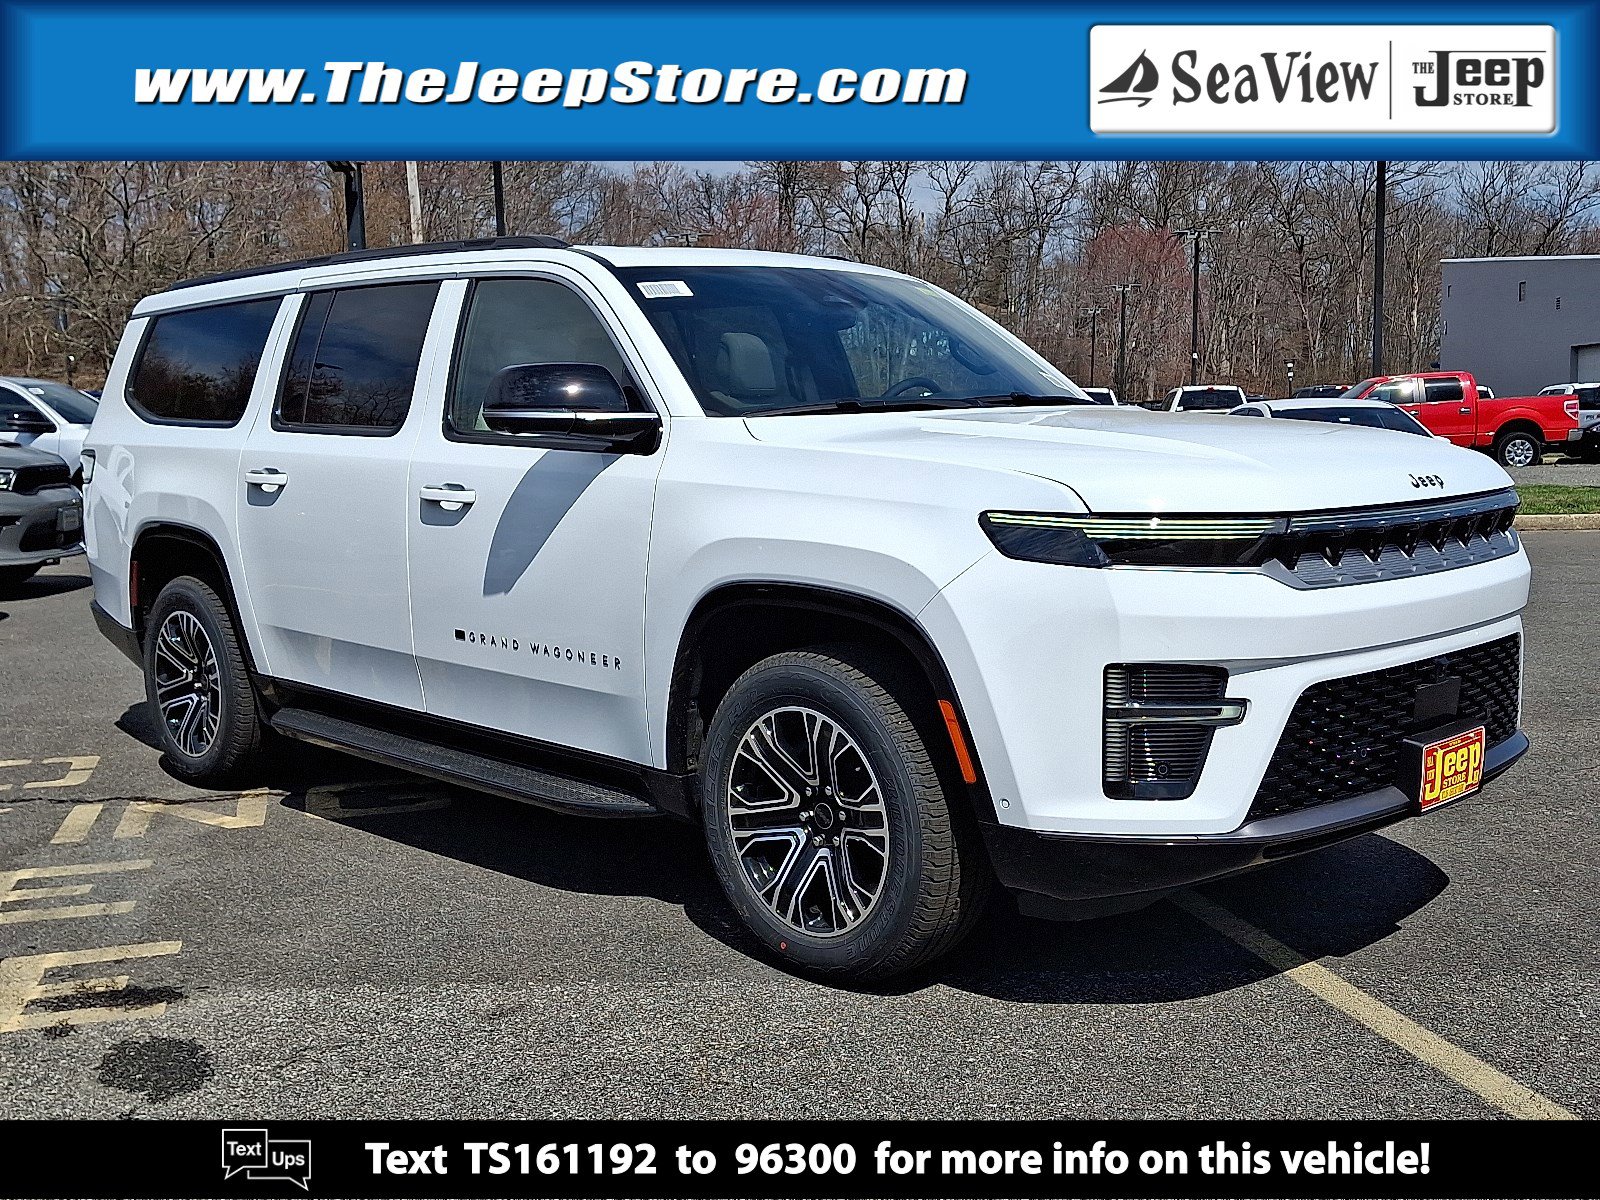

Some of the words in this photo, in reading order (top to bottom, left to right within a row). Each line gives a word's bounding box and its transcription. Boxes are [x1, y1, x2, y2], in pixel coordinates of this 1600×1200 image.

[1408, 473, 1444, 490] Jeep
[469, 631, 519, 651] GRAND
[529, 641, 621, 670] WAGONEER
[1424, 741, 1481, 801] Jeep
[1442, 772, 1467, 788] STORE
